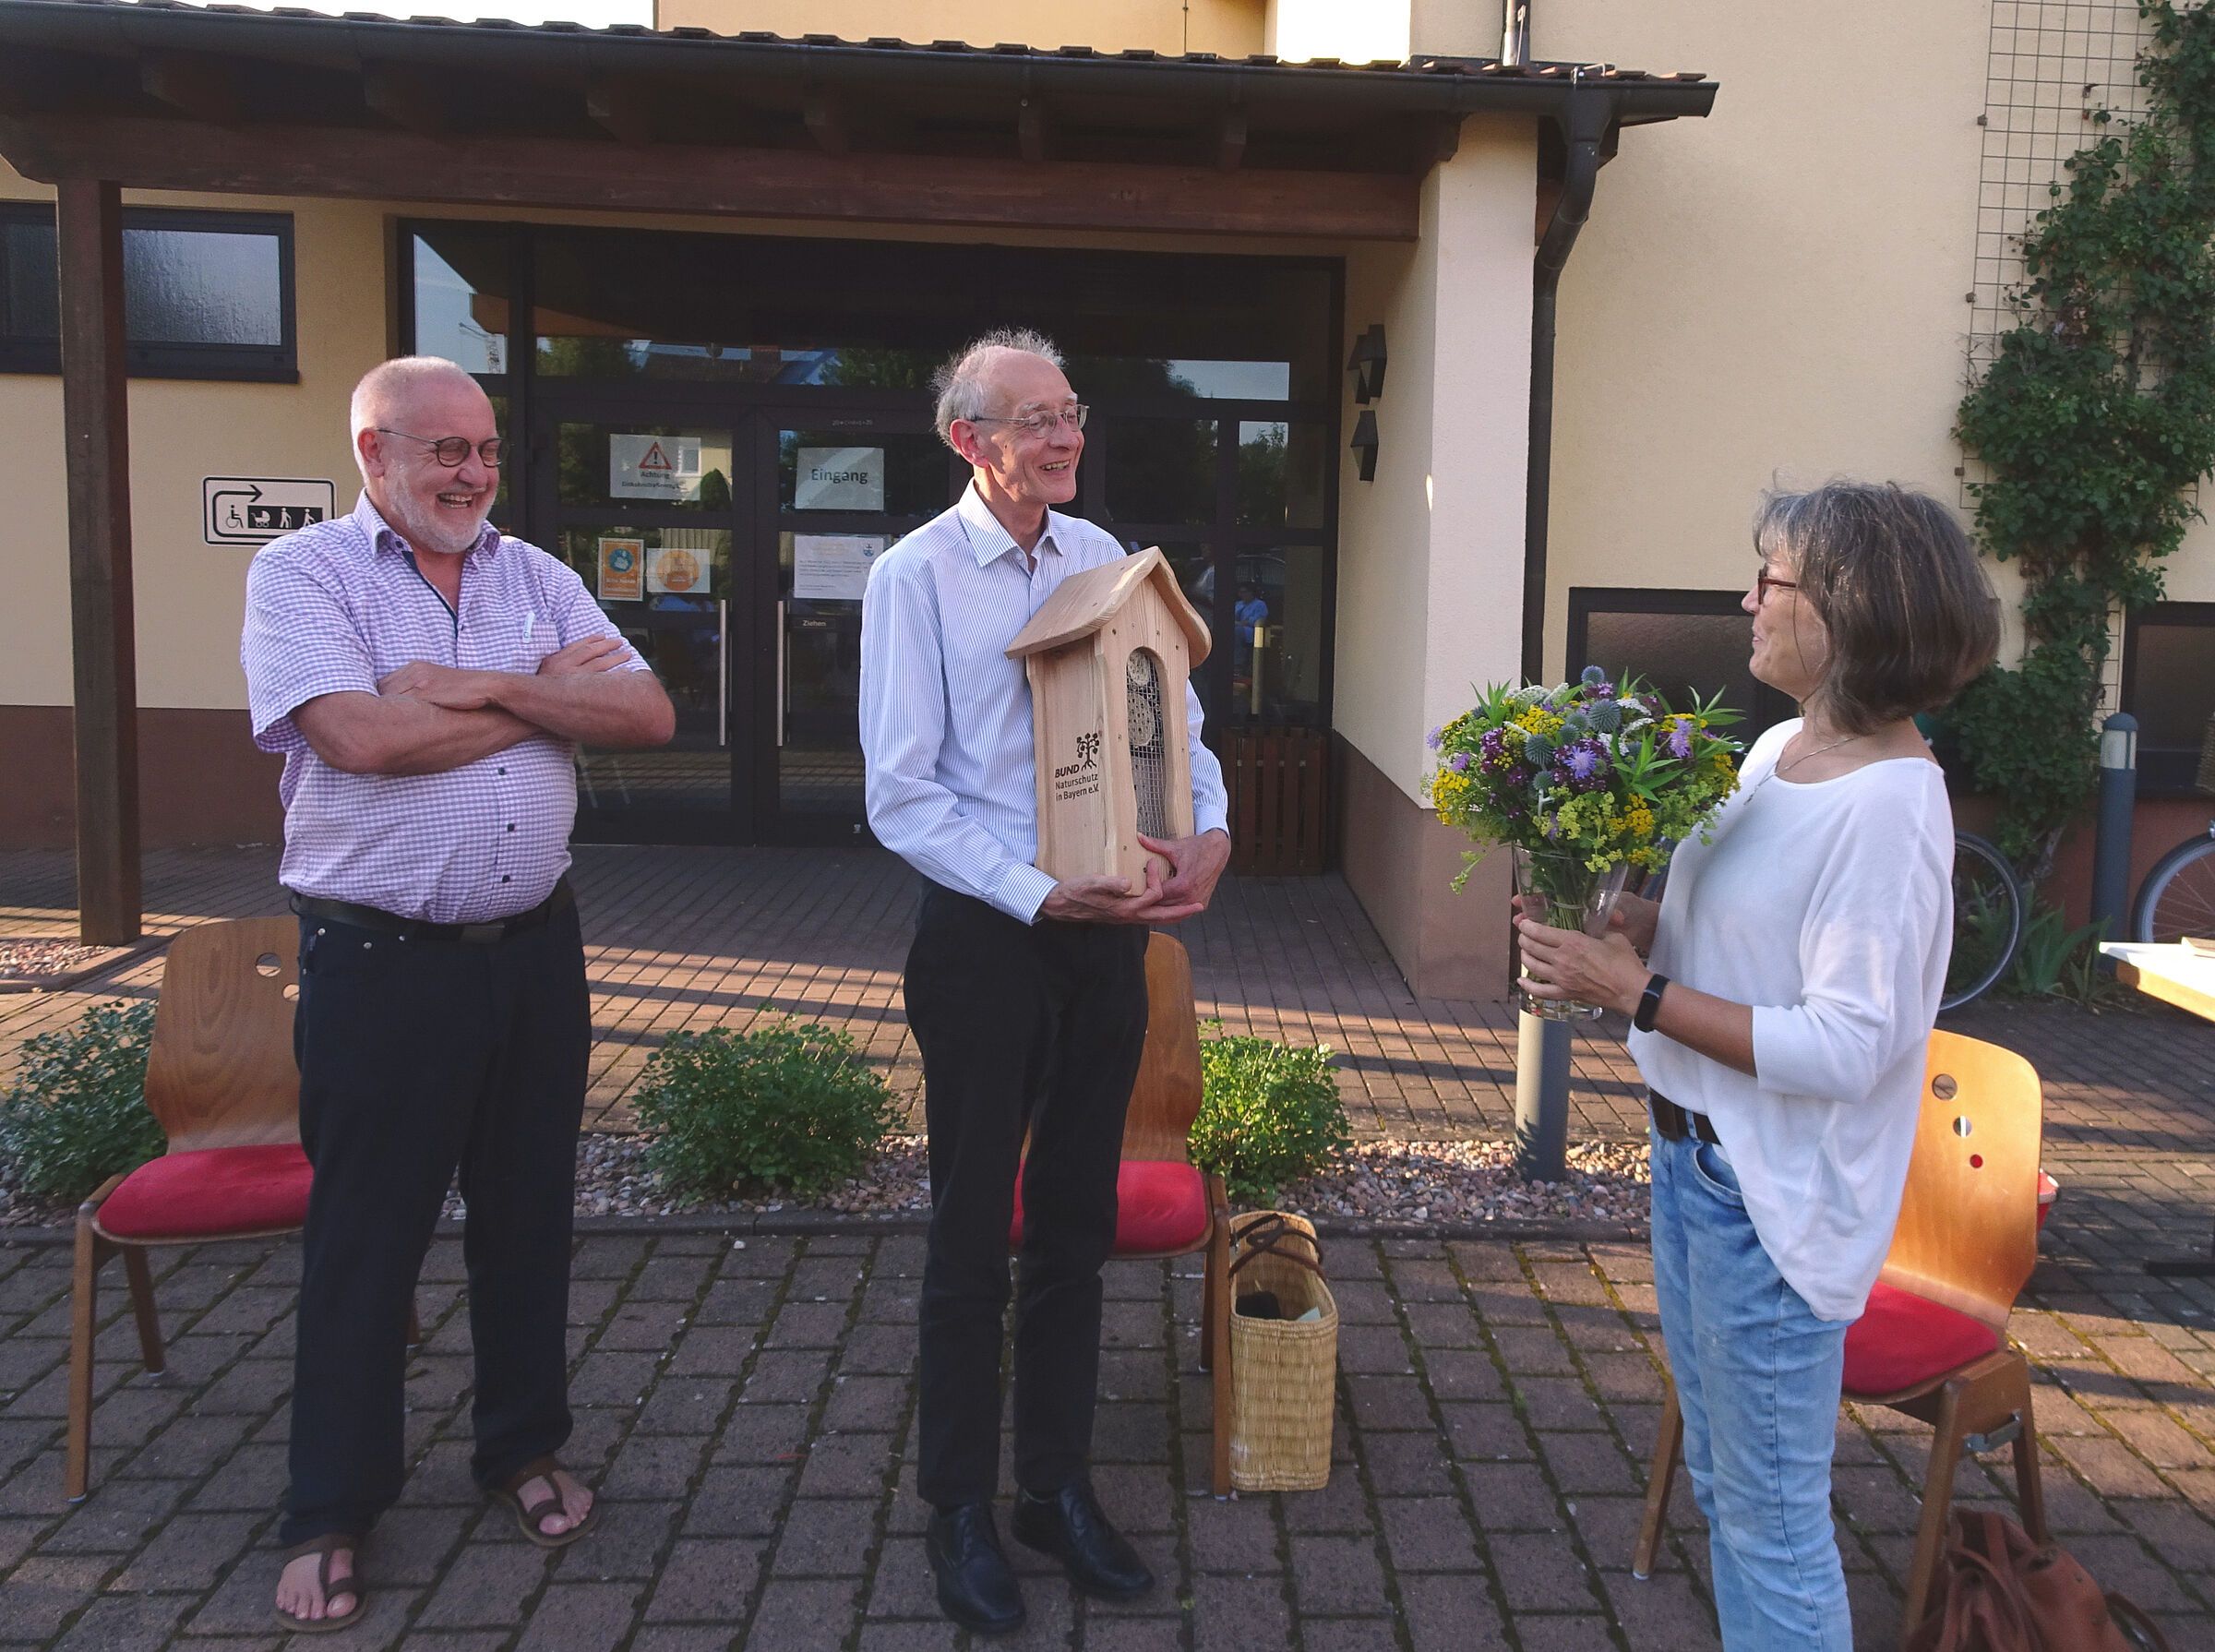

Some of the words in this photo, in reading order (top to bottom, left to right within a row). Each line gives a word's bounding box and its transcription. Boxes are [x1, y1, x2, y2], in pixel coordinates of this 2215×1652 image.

[641, 471, 670, 479] Achtung
[811, 469, 868, 485] Eingang
[1055, 764, 1080, 778] BUND
[1055, 773, 1098, 790] Naturschutz
[1056, 793, 1062, 801] in
[1063, 787, 1087, 800] Bayern
